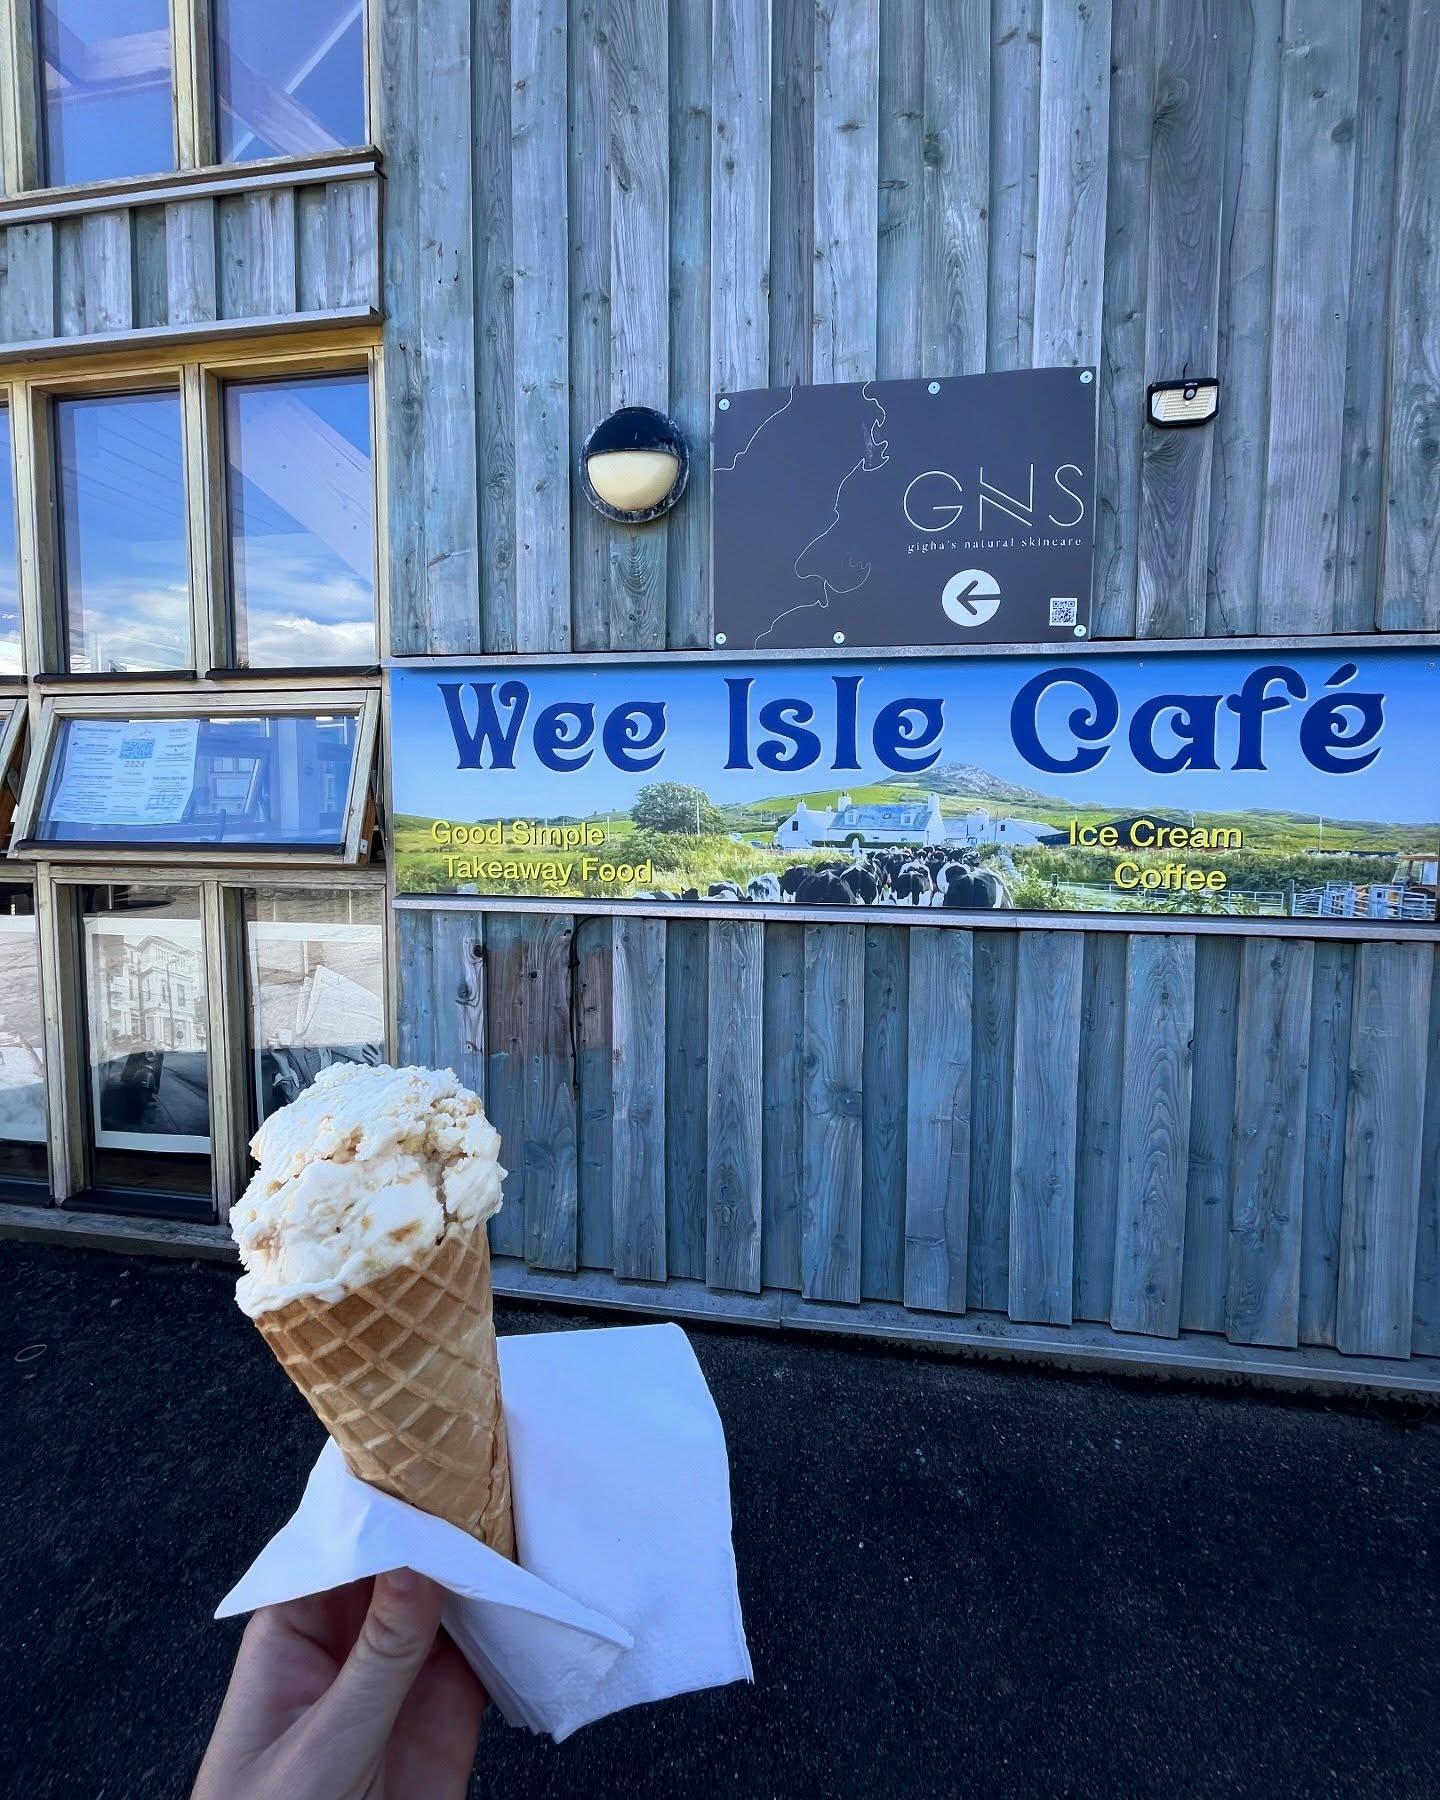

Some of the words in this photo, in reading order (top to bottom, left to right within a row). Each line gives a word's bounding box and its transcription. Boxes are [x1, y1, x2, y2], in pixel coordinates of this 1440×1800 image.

[903, 463, 1085, 532] GNS
[907, 540, 957, 554] gigha's
[964, 538, 1015, 550] natural
[1021, 536, 1082, 547] skincare
[437, 680, 668, 773] Wee
[723, 676, 945, 774] Isle
[1010, 663, 1385, 774] Café
[431, 820, 504, 846] Good
[512, 821, 605, 851] Simple
[1069, 820, 1119, 848] Ice
[1129, 820, 1243, 849] Cream
[443, 854, 574, 886] Takeaway
[581, 856, 653, 883] Food
[1114, 860, 1228, 891] Coffee
